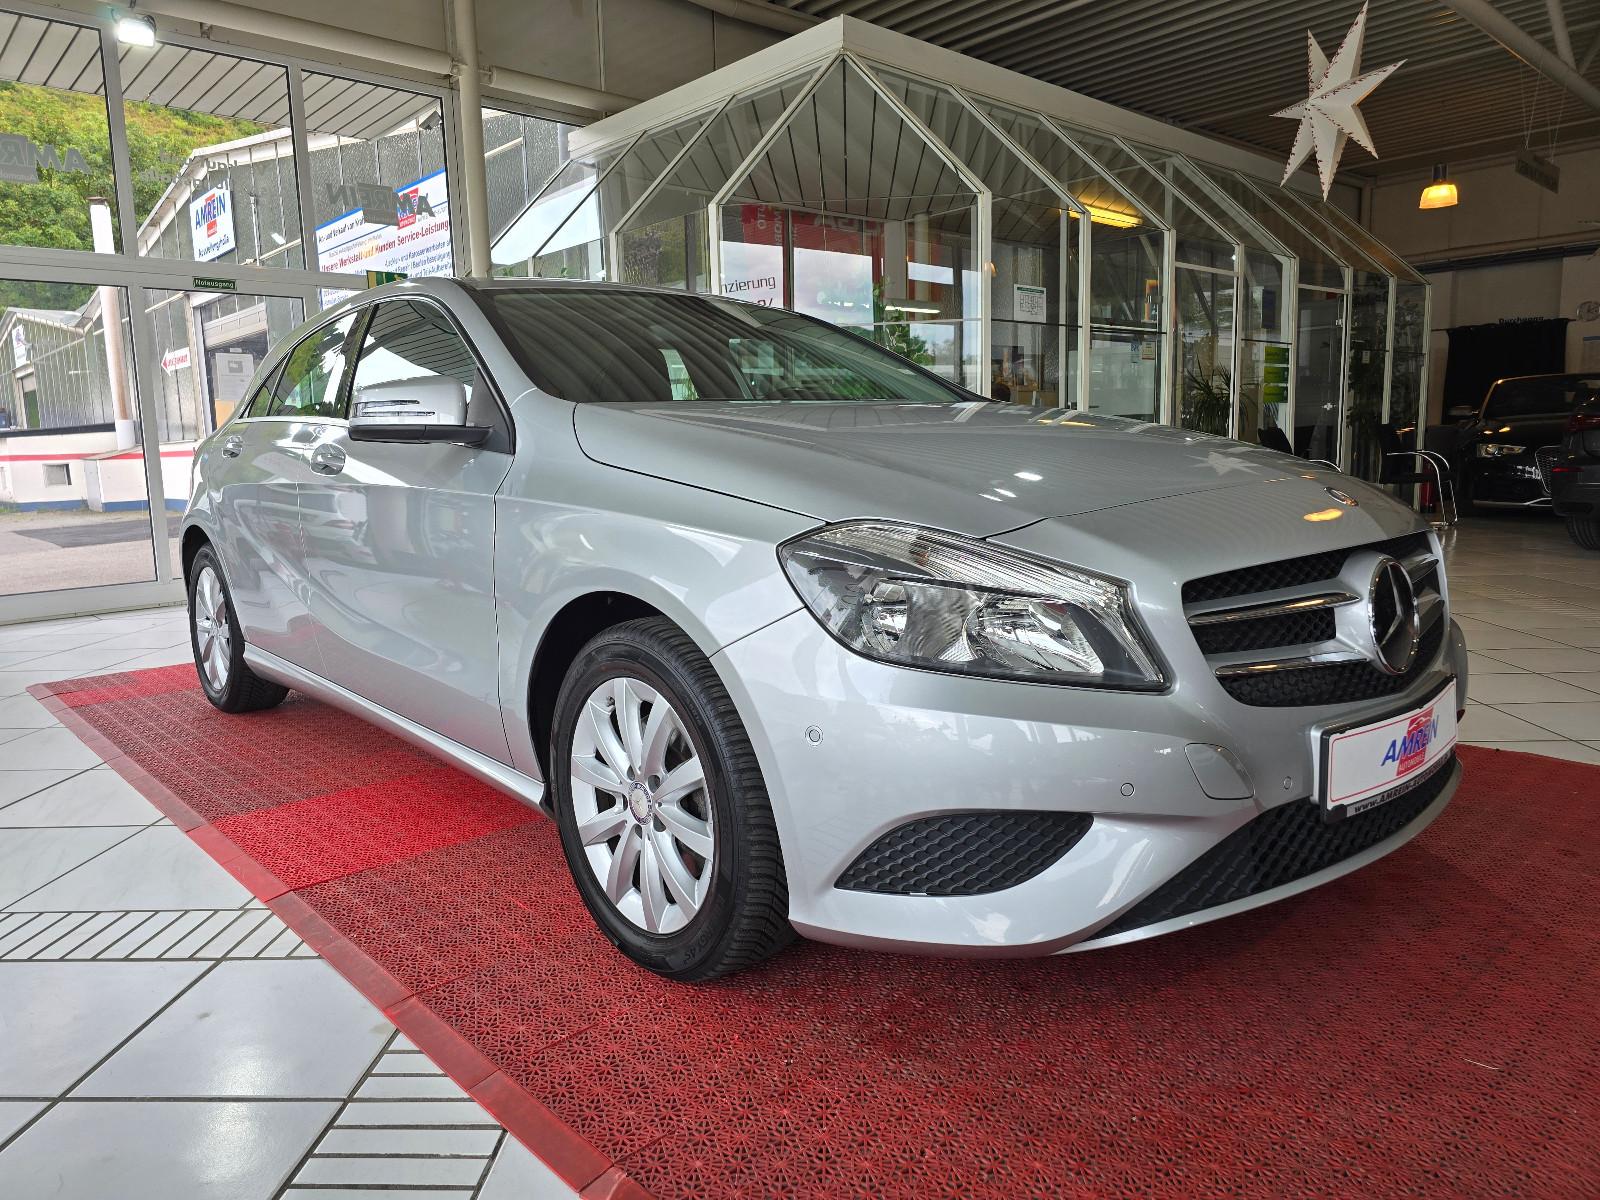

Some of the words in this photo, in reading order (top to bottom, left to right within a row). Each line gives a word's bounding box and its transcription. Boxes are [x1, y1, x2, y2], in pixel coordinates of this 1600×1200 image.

[195, 193, 226, 230] AMREIN
[194, 279, 234, 289] Notausgang
[1381, 714, 1440, 767] AMREIN
